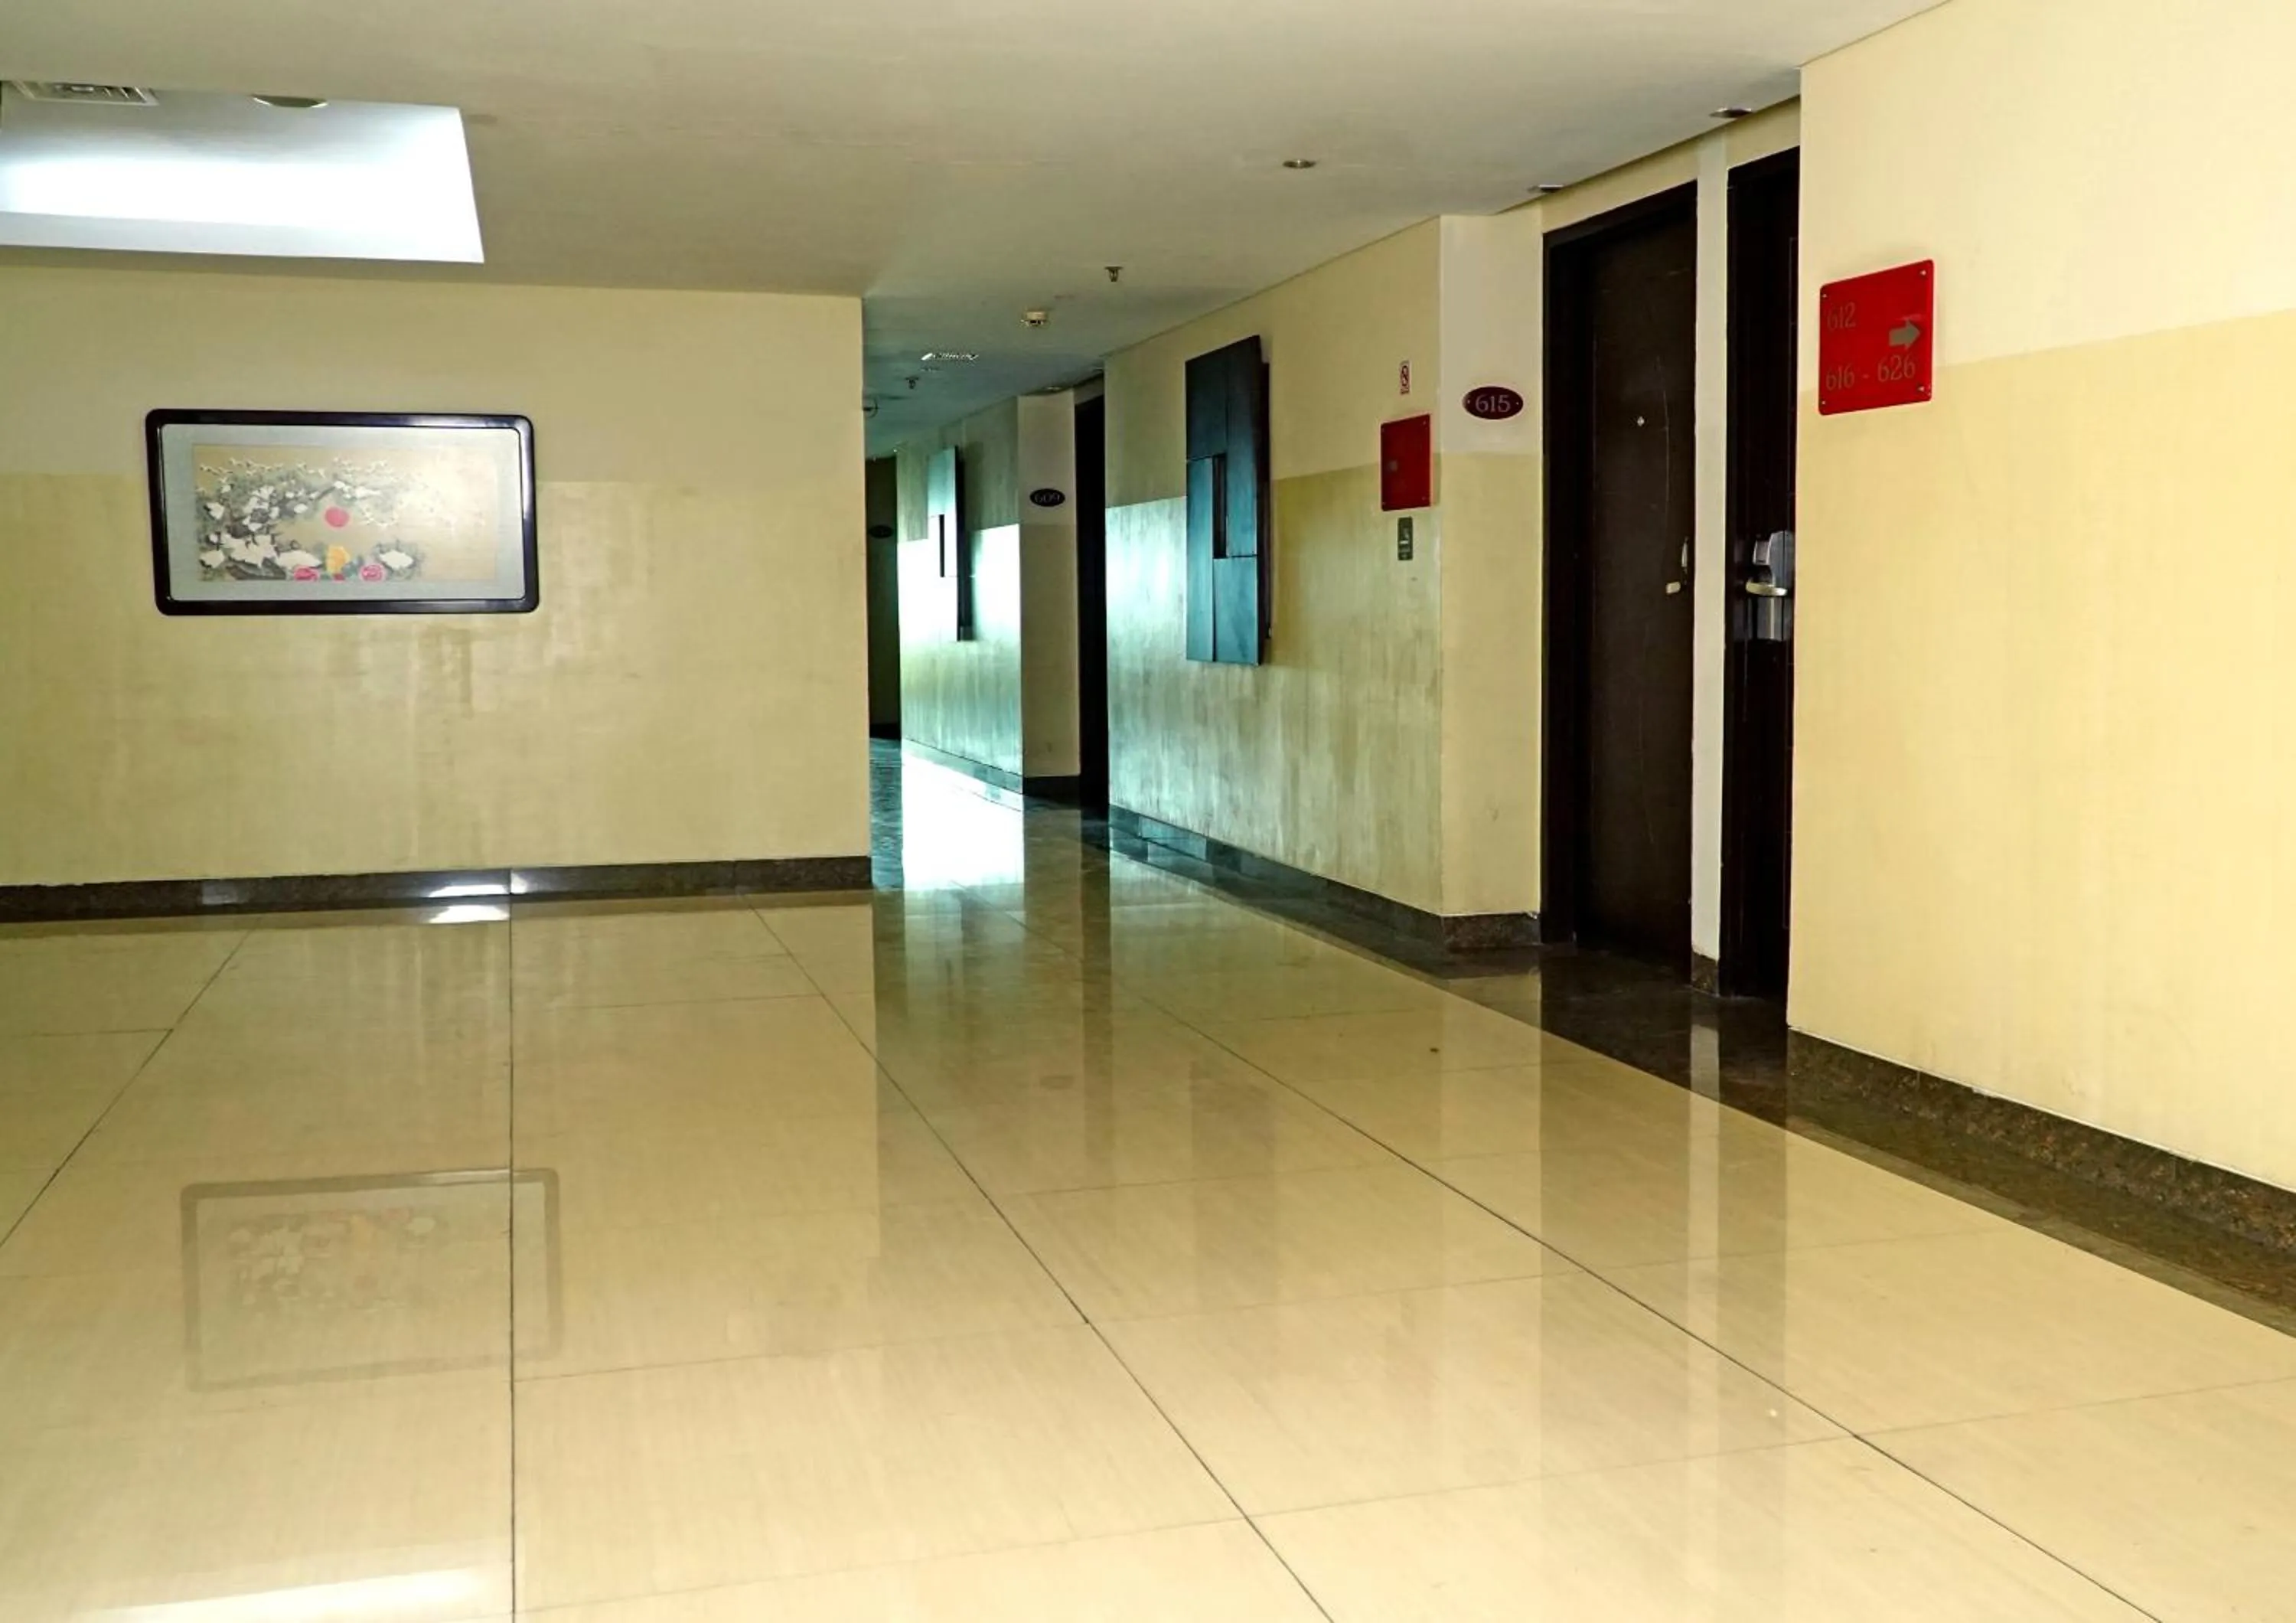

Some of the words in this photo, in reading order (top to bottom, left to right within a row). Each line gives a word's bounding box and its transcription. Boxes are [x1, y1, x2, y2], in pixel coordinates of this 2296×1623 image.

[1827, 302, 1857, 331] 612
[1825, 363, 1855, 390] 616
[1877, 353, 1916, 382] 626
[1475, 394, 1511, 413] 615
[1034, 491, 1060, 503] 609
